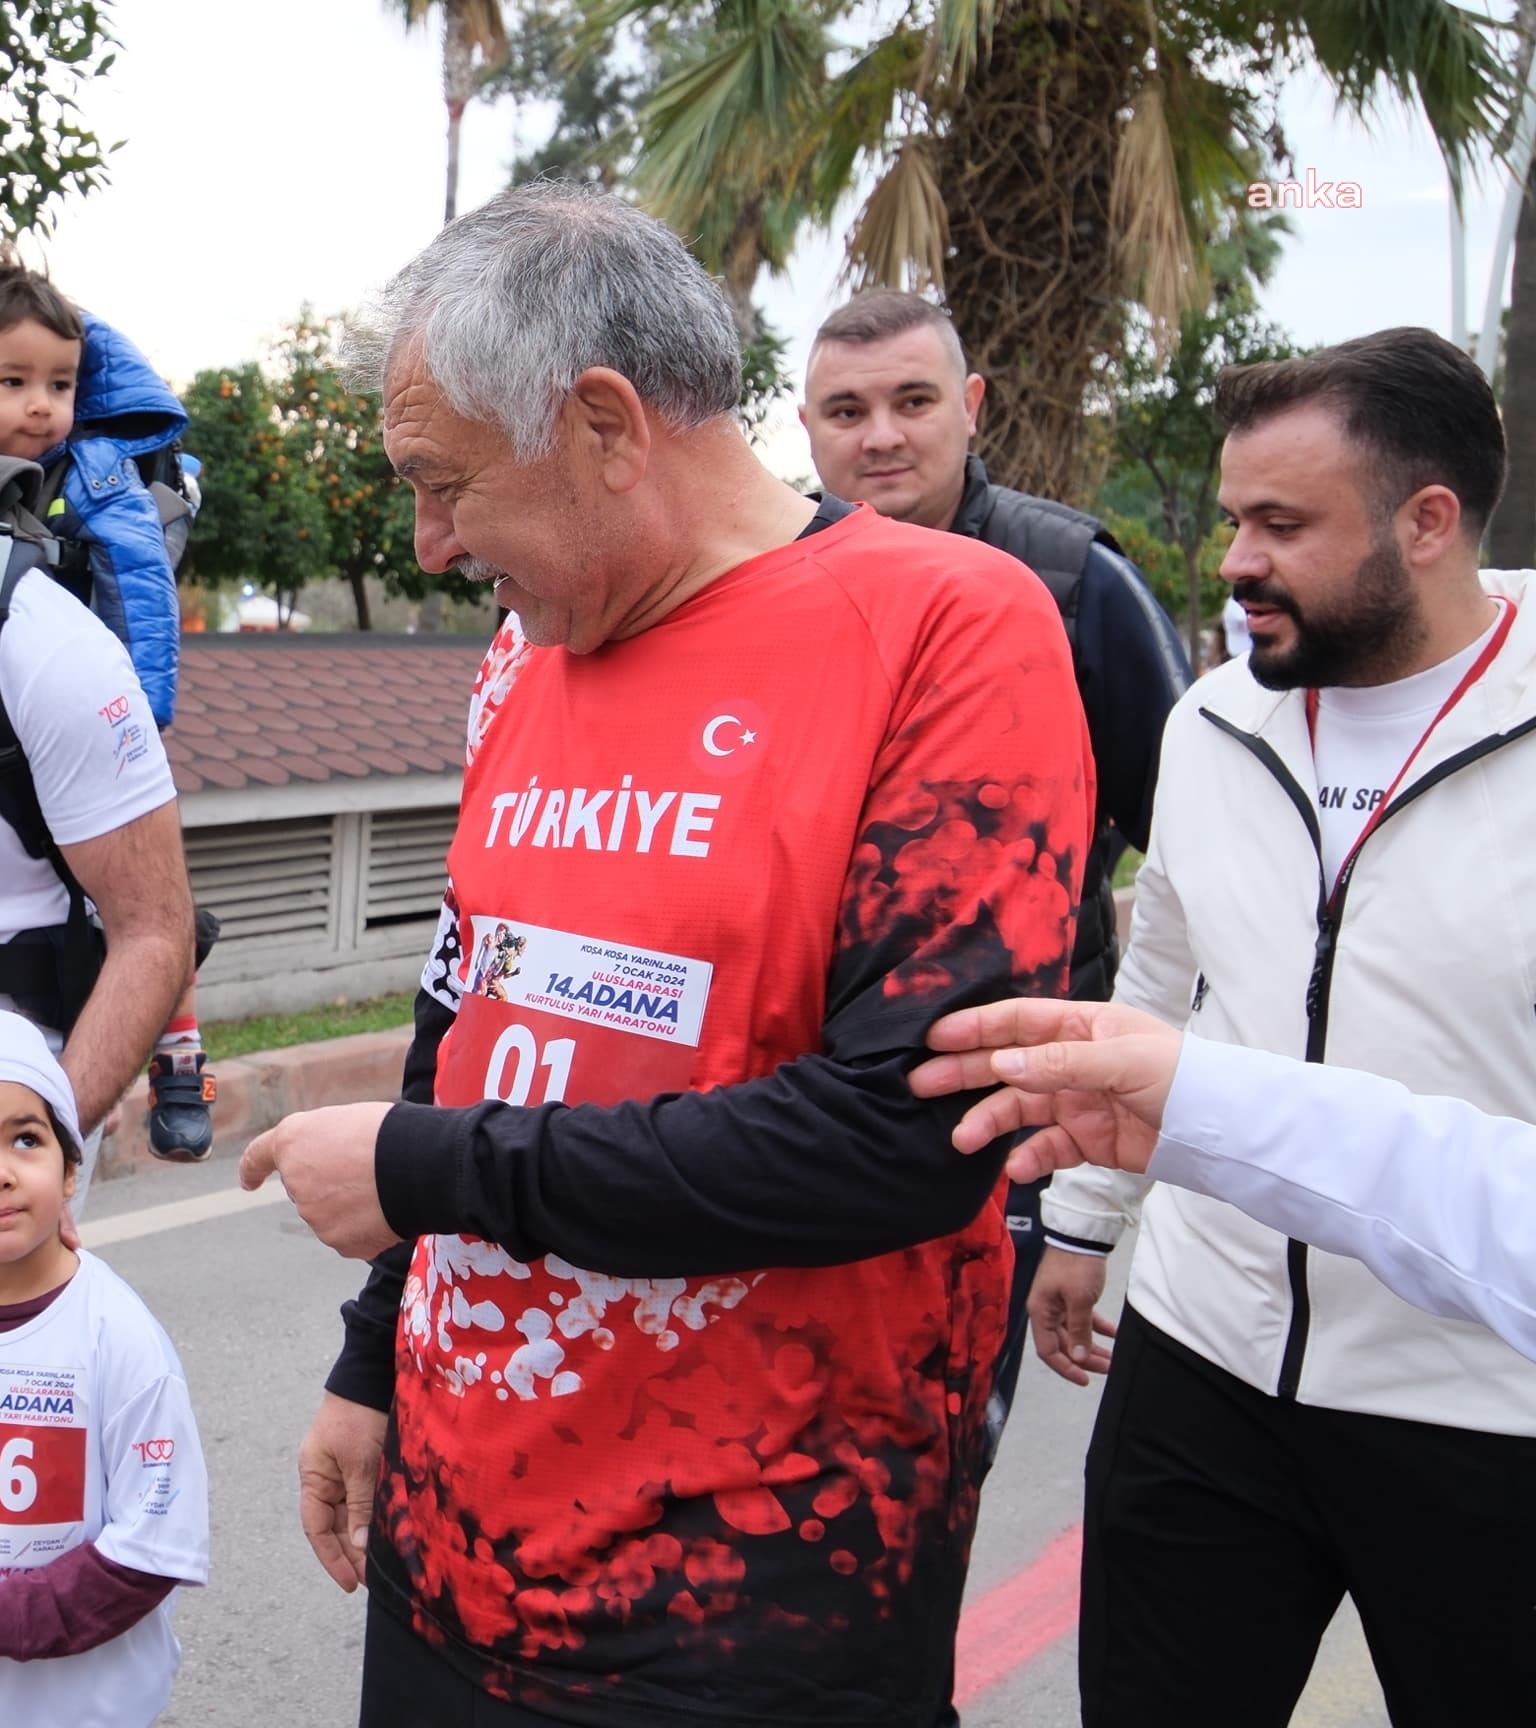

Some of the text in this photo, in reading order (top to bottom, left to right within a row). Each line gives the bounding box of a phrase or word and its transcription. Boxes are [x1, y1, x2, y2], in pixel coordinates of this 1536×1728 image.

[484, 774, 722, 858] TÜRKİYE
[580, 944, 687, 975] KOŞA KOŞA YARINLARA
[592, 971, 684, 999] ULUSLARARASI
[614, 963, 686, 987] 7 OCAK 2024
[545, 973, 679, 1023] 14.ADANA
[524, 992, 676, 1035] KURTULUŞ YARI MARATONU
[484, 1023, 577, 1107] 01
[10, 1386, 74, 1397] ULUSLARARASI
[54, 1381, 75, 1389] 2024
[4, 1412, 22, 1420] YARI
[23, 1413, 74, 1424] MARATONU
